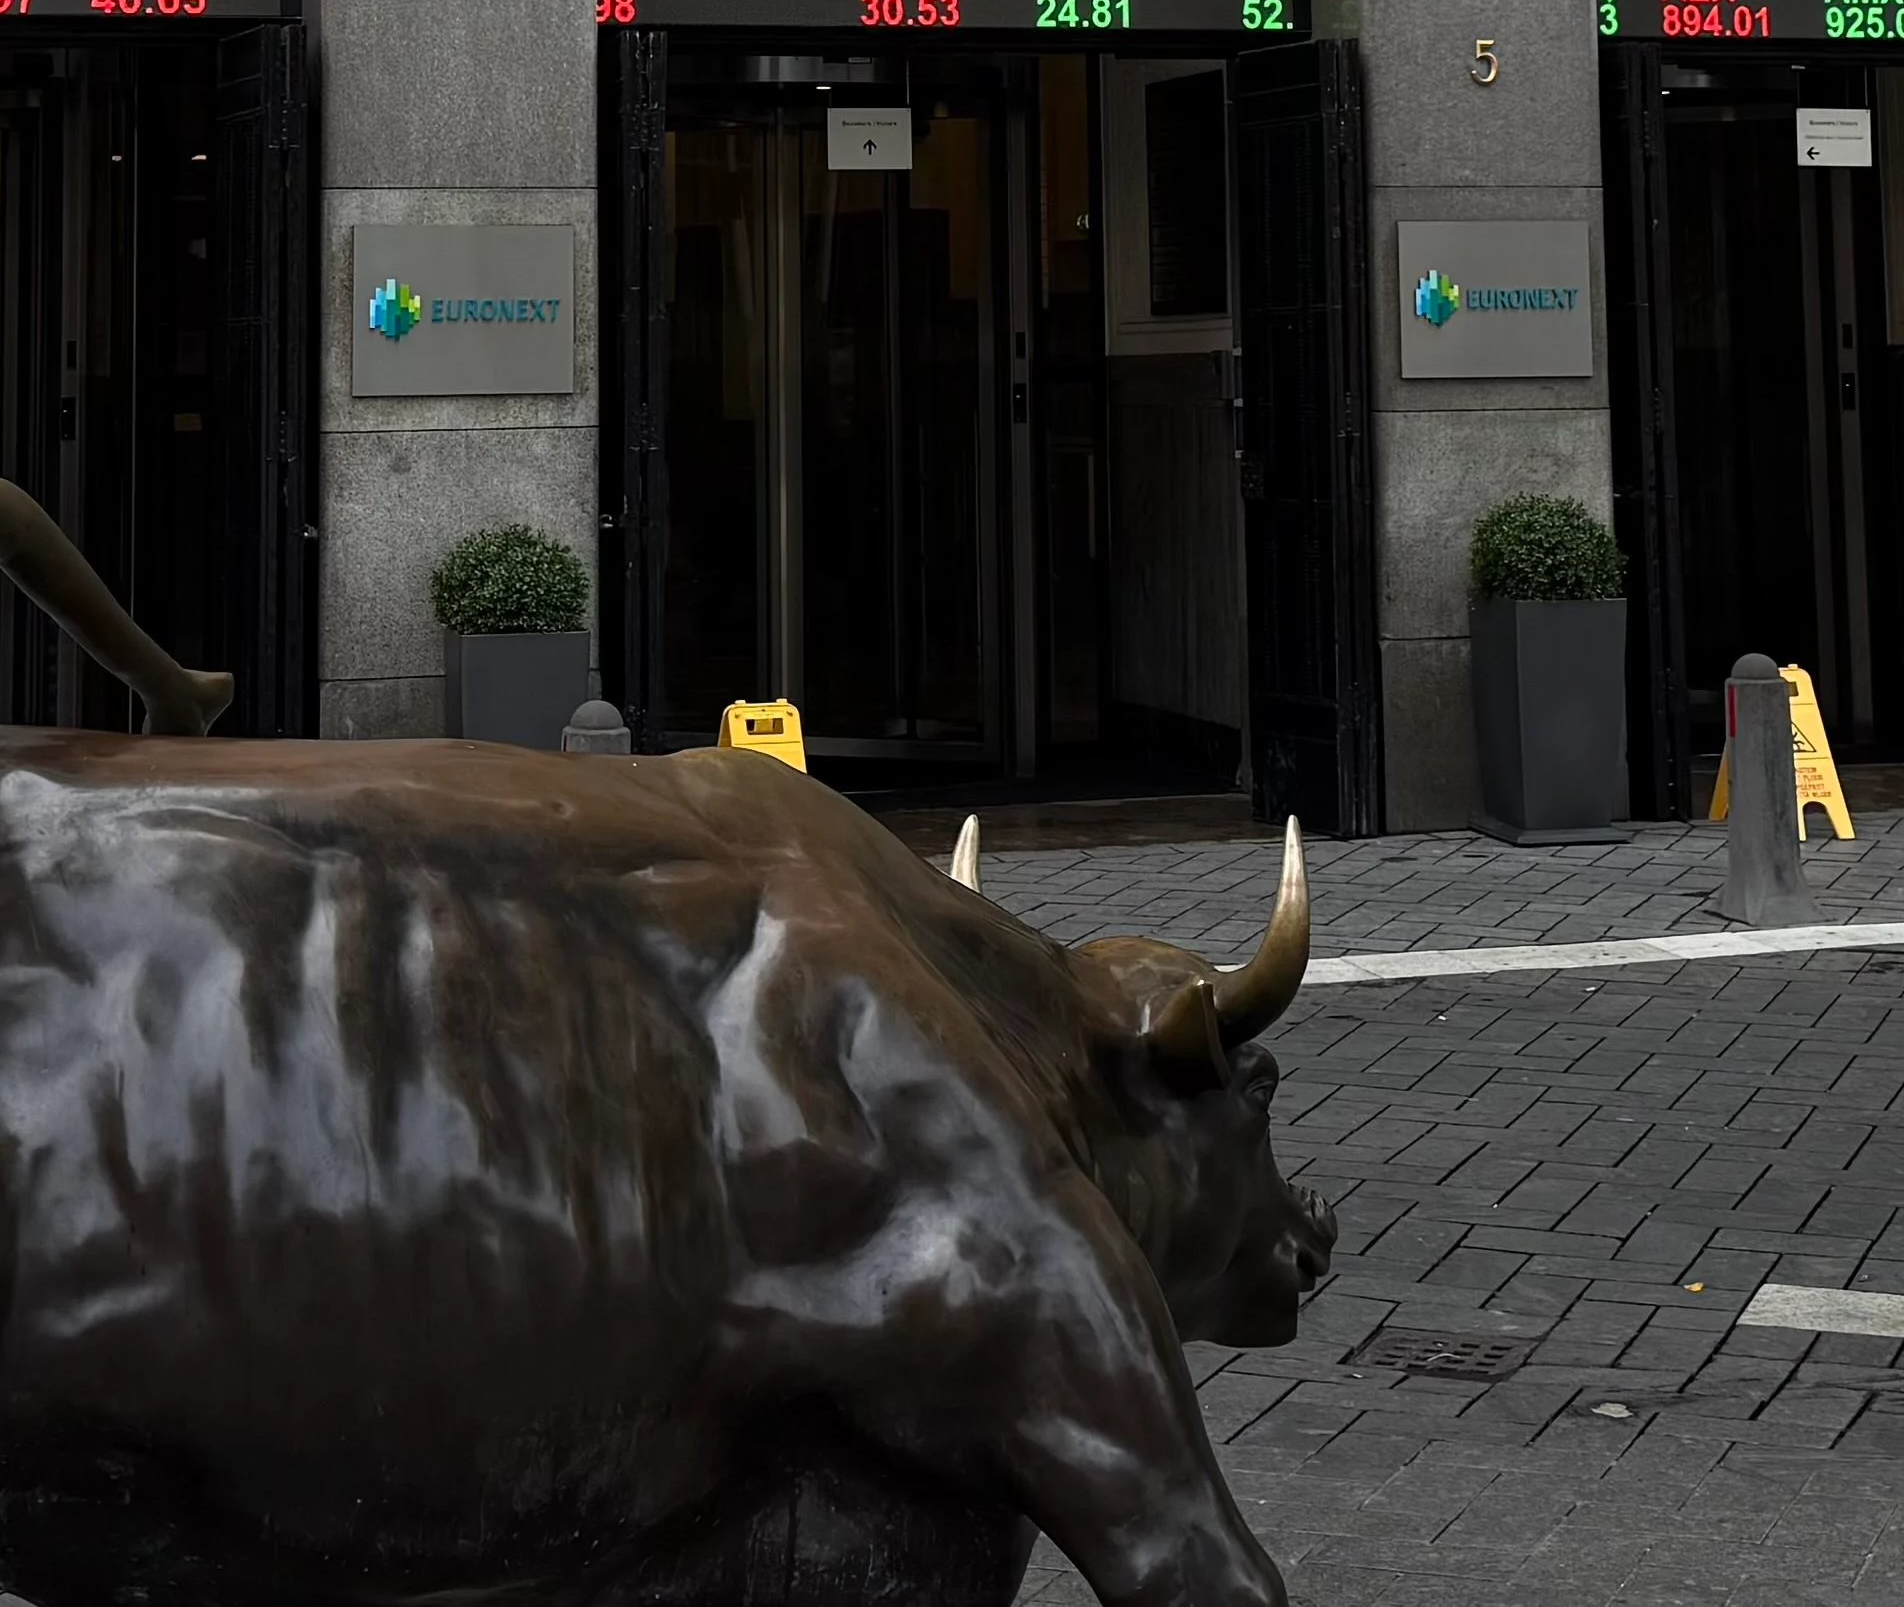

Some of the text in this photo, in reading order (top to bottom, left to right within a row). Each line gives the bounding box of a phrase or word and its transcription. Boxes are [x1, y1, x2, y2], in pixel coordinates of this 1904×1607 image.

[1663, 5, 1771, 37] 894.01
[1471, 39, 1498, 85] 5
[431, 298, 560, 323] EURONEXT
[1466, 289, 1578, 311] EURONEXT
